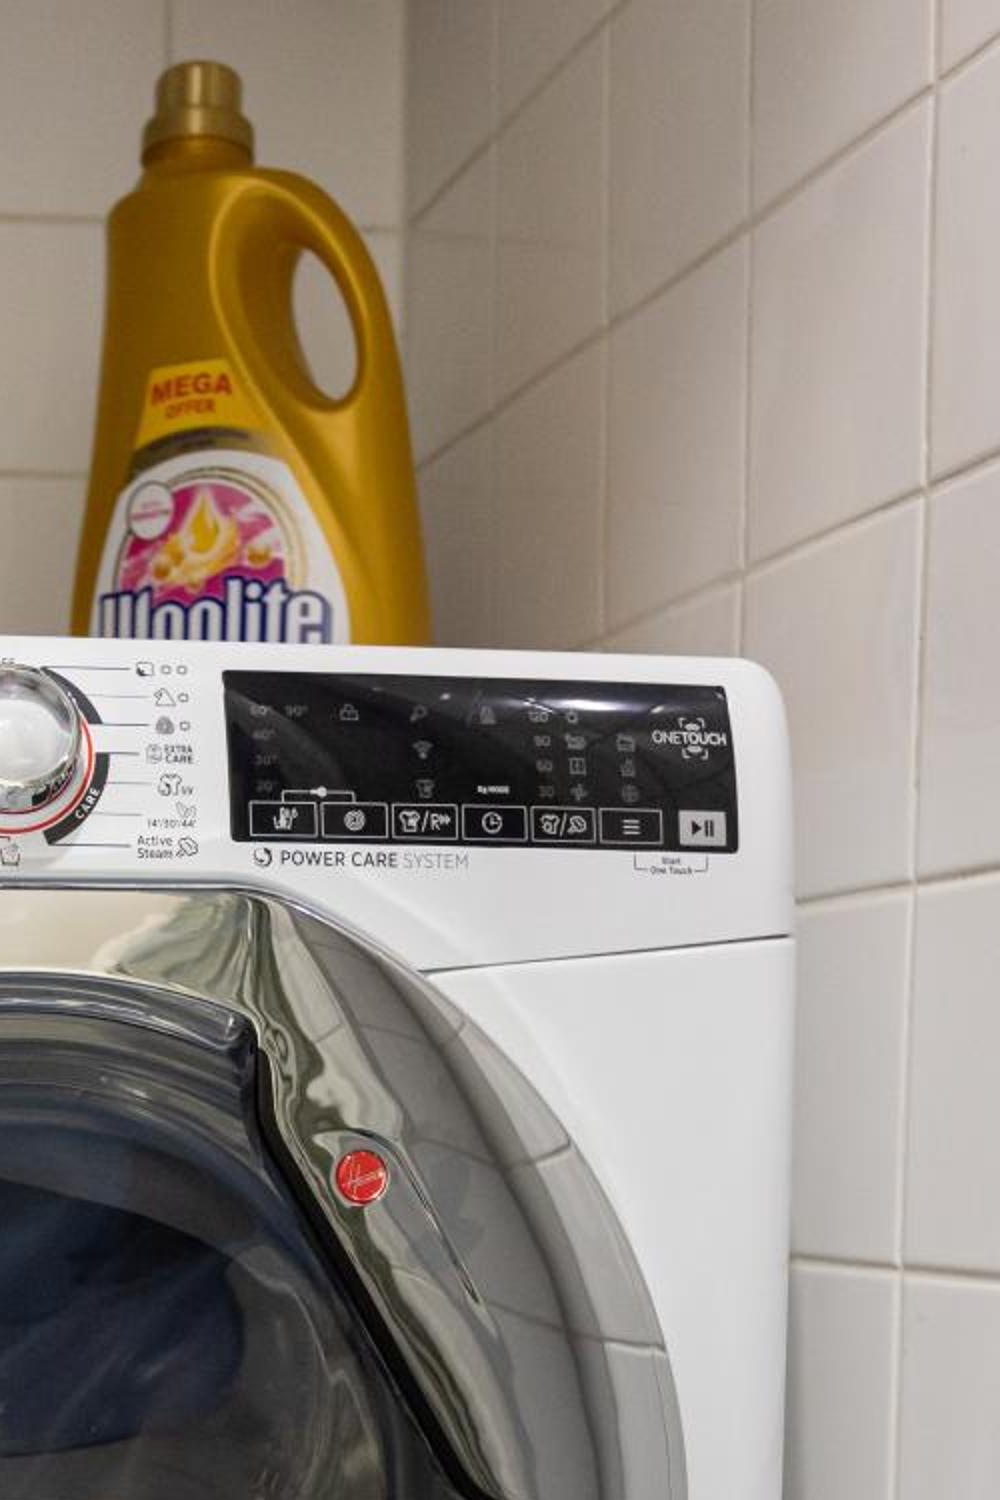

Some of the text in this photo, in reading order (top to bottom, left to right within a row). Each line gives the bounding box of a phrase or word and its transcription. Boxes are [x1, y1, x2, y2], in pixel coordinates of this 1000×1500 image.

[151, 372, 233, 407] MEGA
[165, 398, 216, 419] OFFER
[651, 730, 727, 746] ONETOUCH
[75, 787, 101, 819] CARE
[137, 836, 174, 847] Active
[280, 850, 470, 869] POWER CARE SYSTEM
